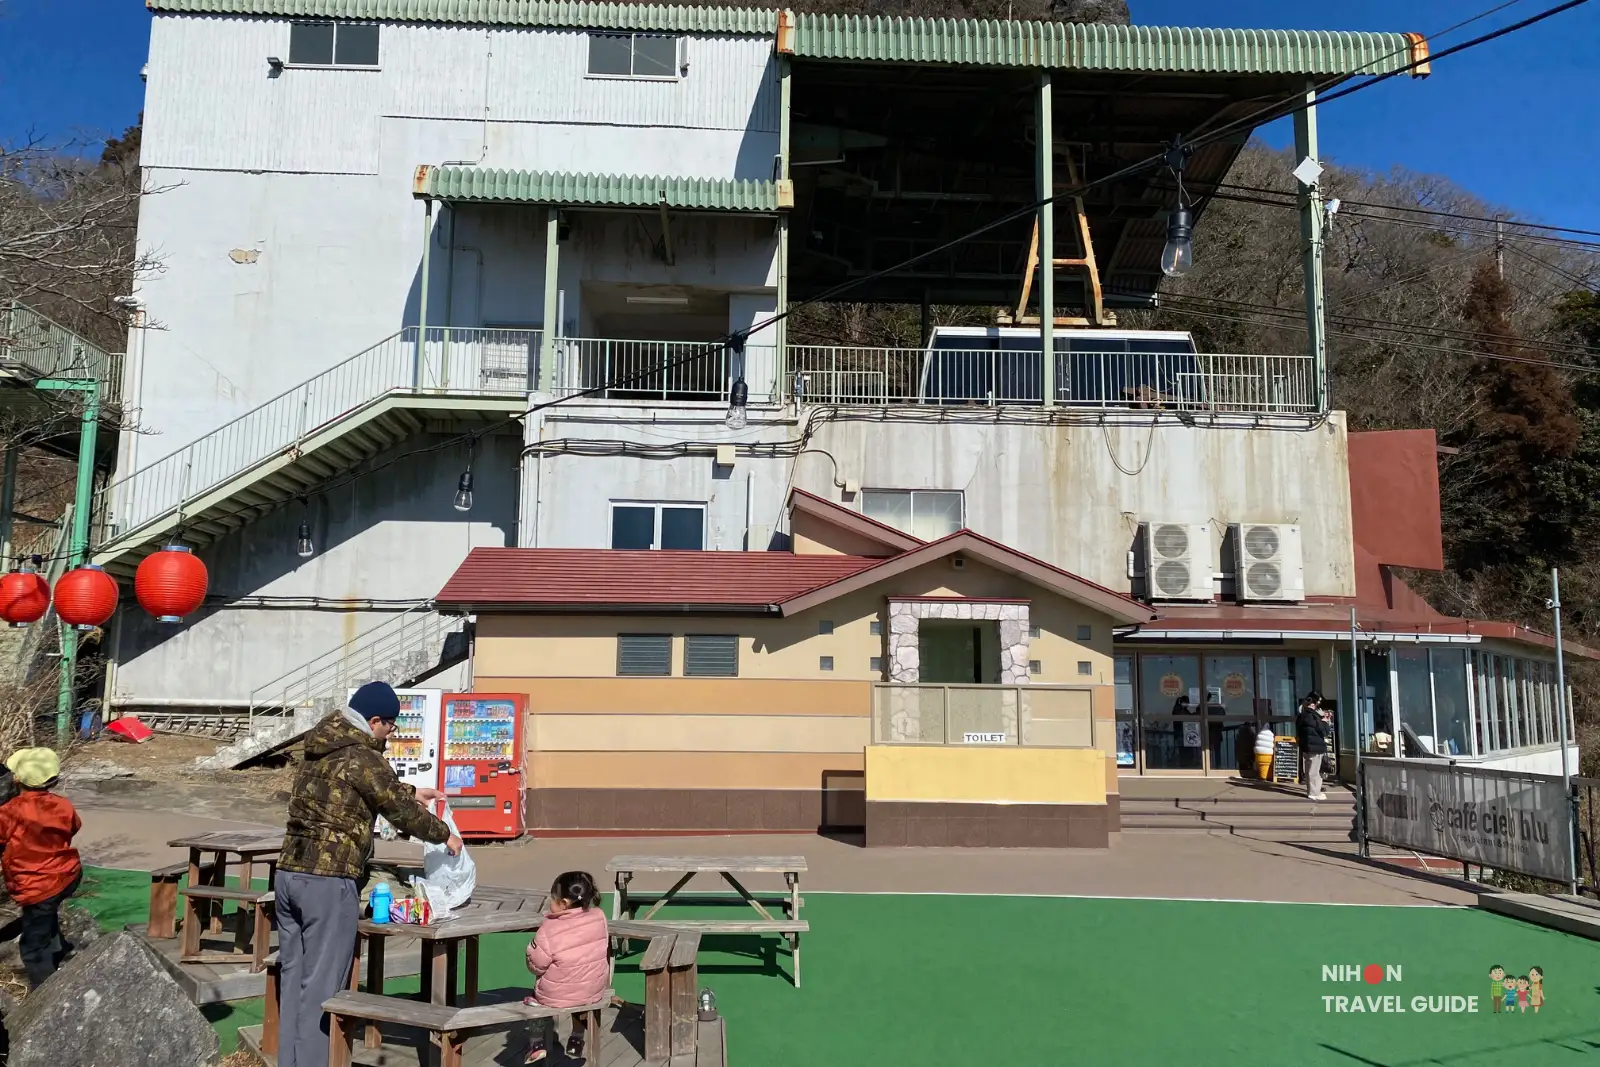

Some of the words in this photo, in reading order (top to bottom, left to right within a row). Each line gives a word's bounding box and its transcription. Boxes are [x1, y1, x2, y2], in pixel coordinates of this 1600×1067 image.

[965, 734, 1003, 742] TOILET
[1447, 802, 1477, 831] café
[1521, 810, 1548, 844] blu
